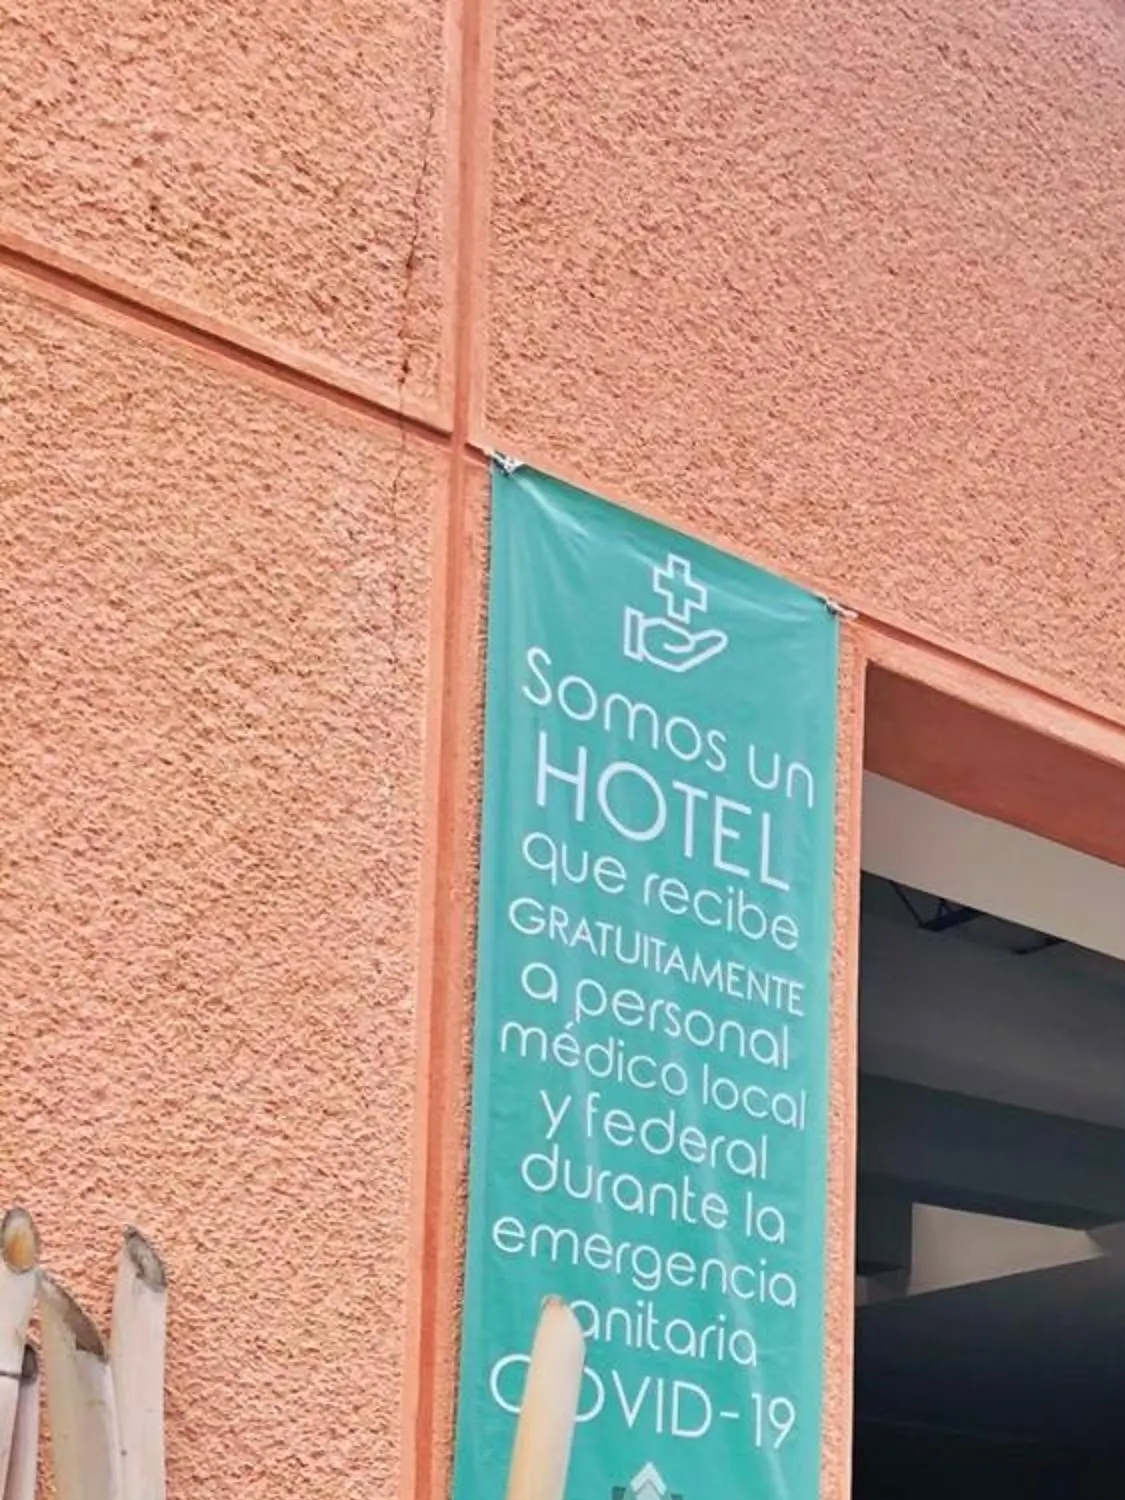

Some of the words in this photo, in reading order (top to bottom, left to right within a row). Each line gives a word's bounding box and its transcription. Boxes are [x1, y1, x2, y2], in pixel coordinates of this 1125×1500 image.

[521, 646, 727, 773] Somos
[748, 744, 813, 808] un
[536, 730, 790, 892] HOTEL
[522, 831, 627, 894] que
[643, 872, 799, 951] recibe
[508, 897, 804, 1017] GRATUITAMENTE
[520, 962, 558, 1003] a
[574, 978, 789, 1069] personal
[501, 1020, 688, 1096] médico
[703, 1063, 806, 1130] local
[540, 1089, 572, 1140] y
[586, 1092, 767, 1179] federal
[520, 1143, 729, 1230] durante
[746, 1191, 785, 1244] la
[492, 1216, 797, 1308] emergencia
[568, 1299, 758, 1369] anitaria
